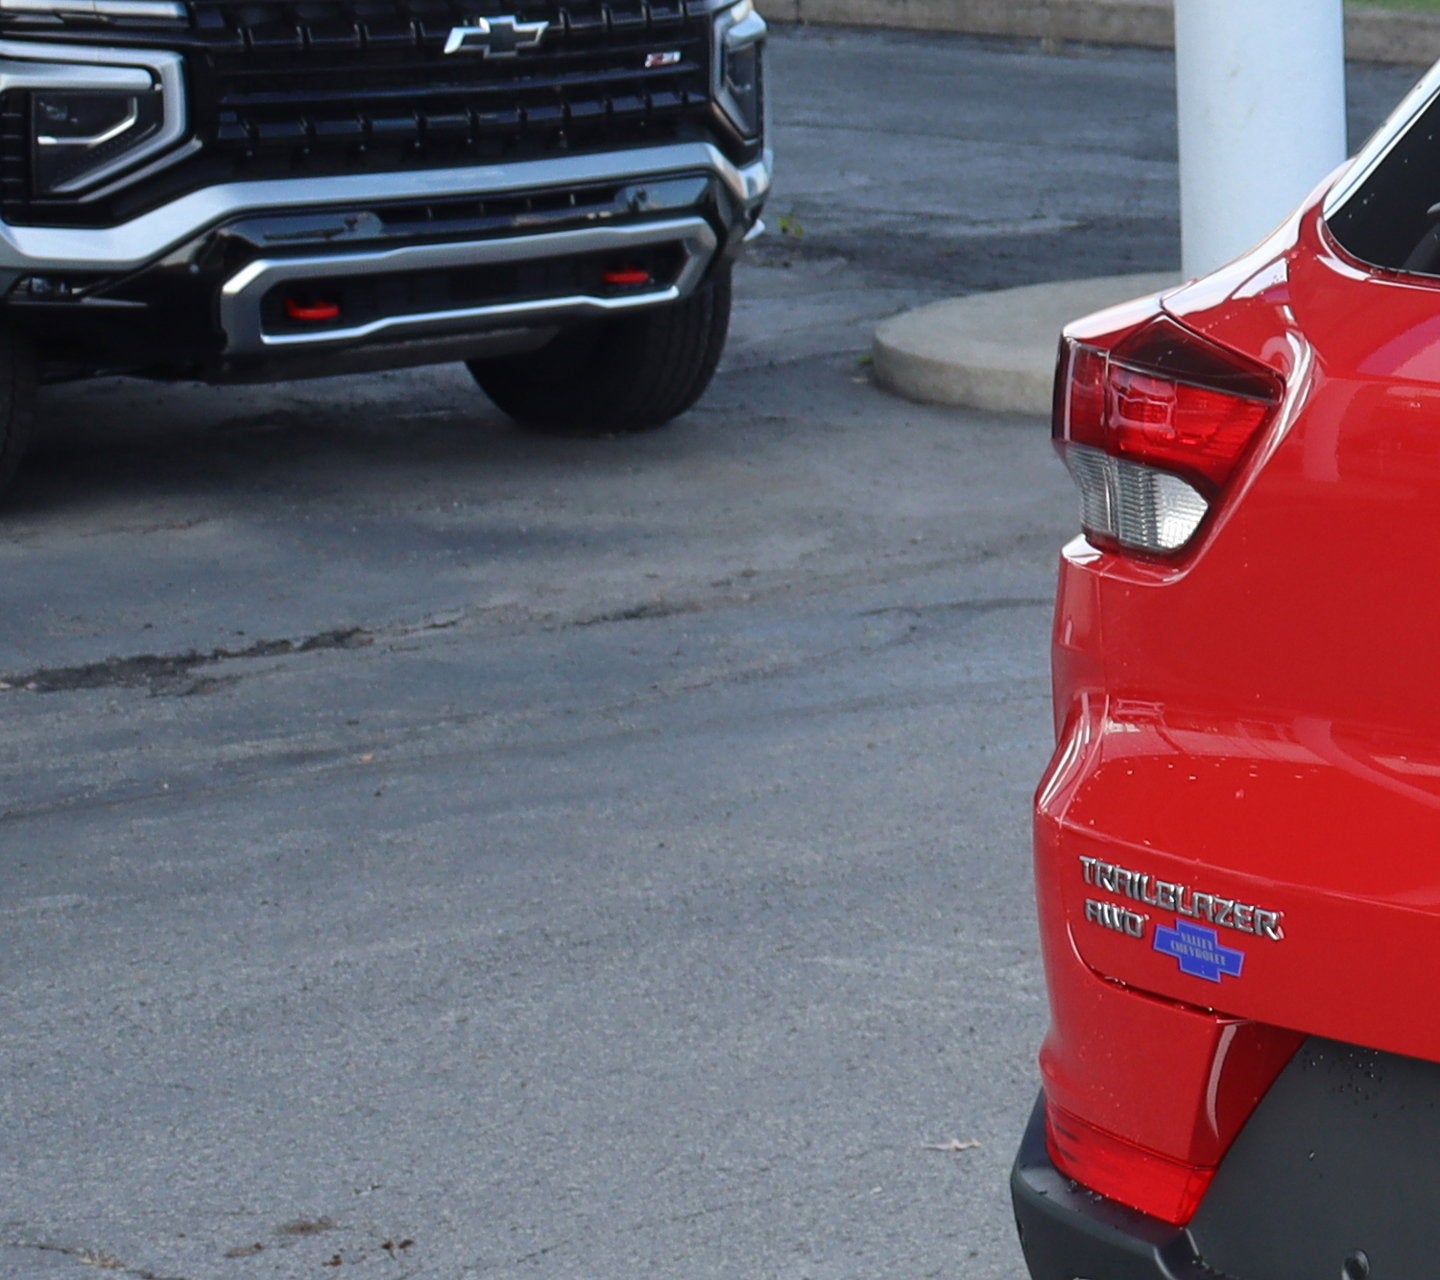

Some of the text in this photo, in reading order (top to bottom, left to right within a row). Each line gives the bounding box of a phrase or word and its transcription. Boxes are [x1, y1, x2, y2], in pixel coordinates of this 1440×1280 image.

[1078, 855, 1283, 941] TRAILBLAZER
[1084, 898, 1145, 939] AWD
[1169, 939, 1227, 966] CHEVROLET
[1180, 932, 1214, 951] VALLEY
